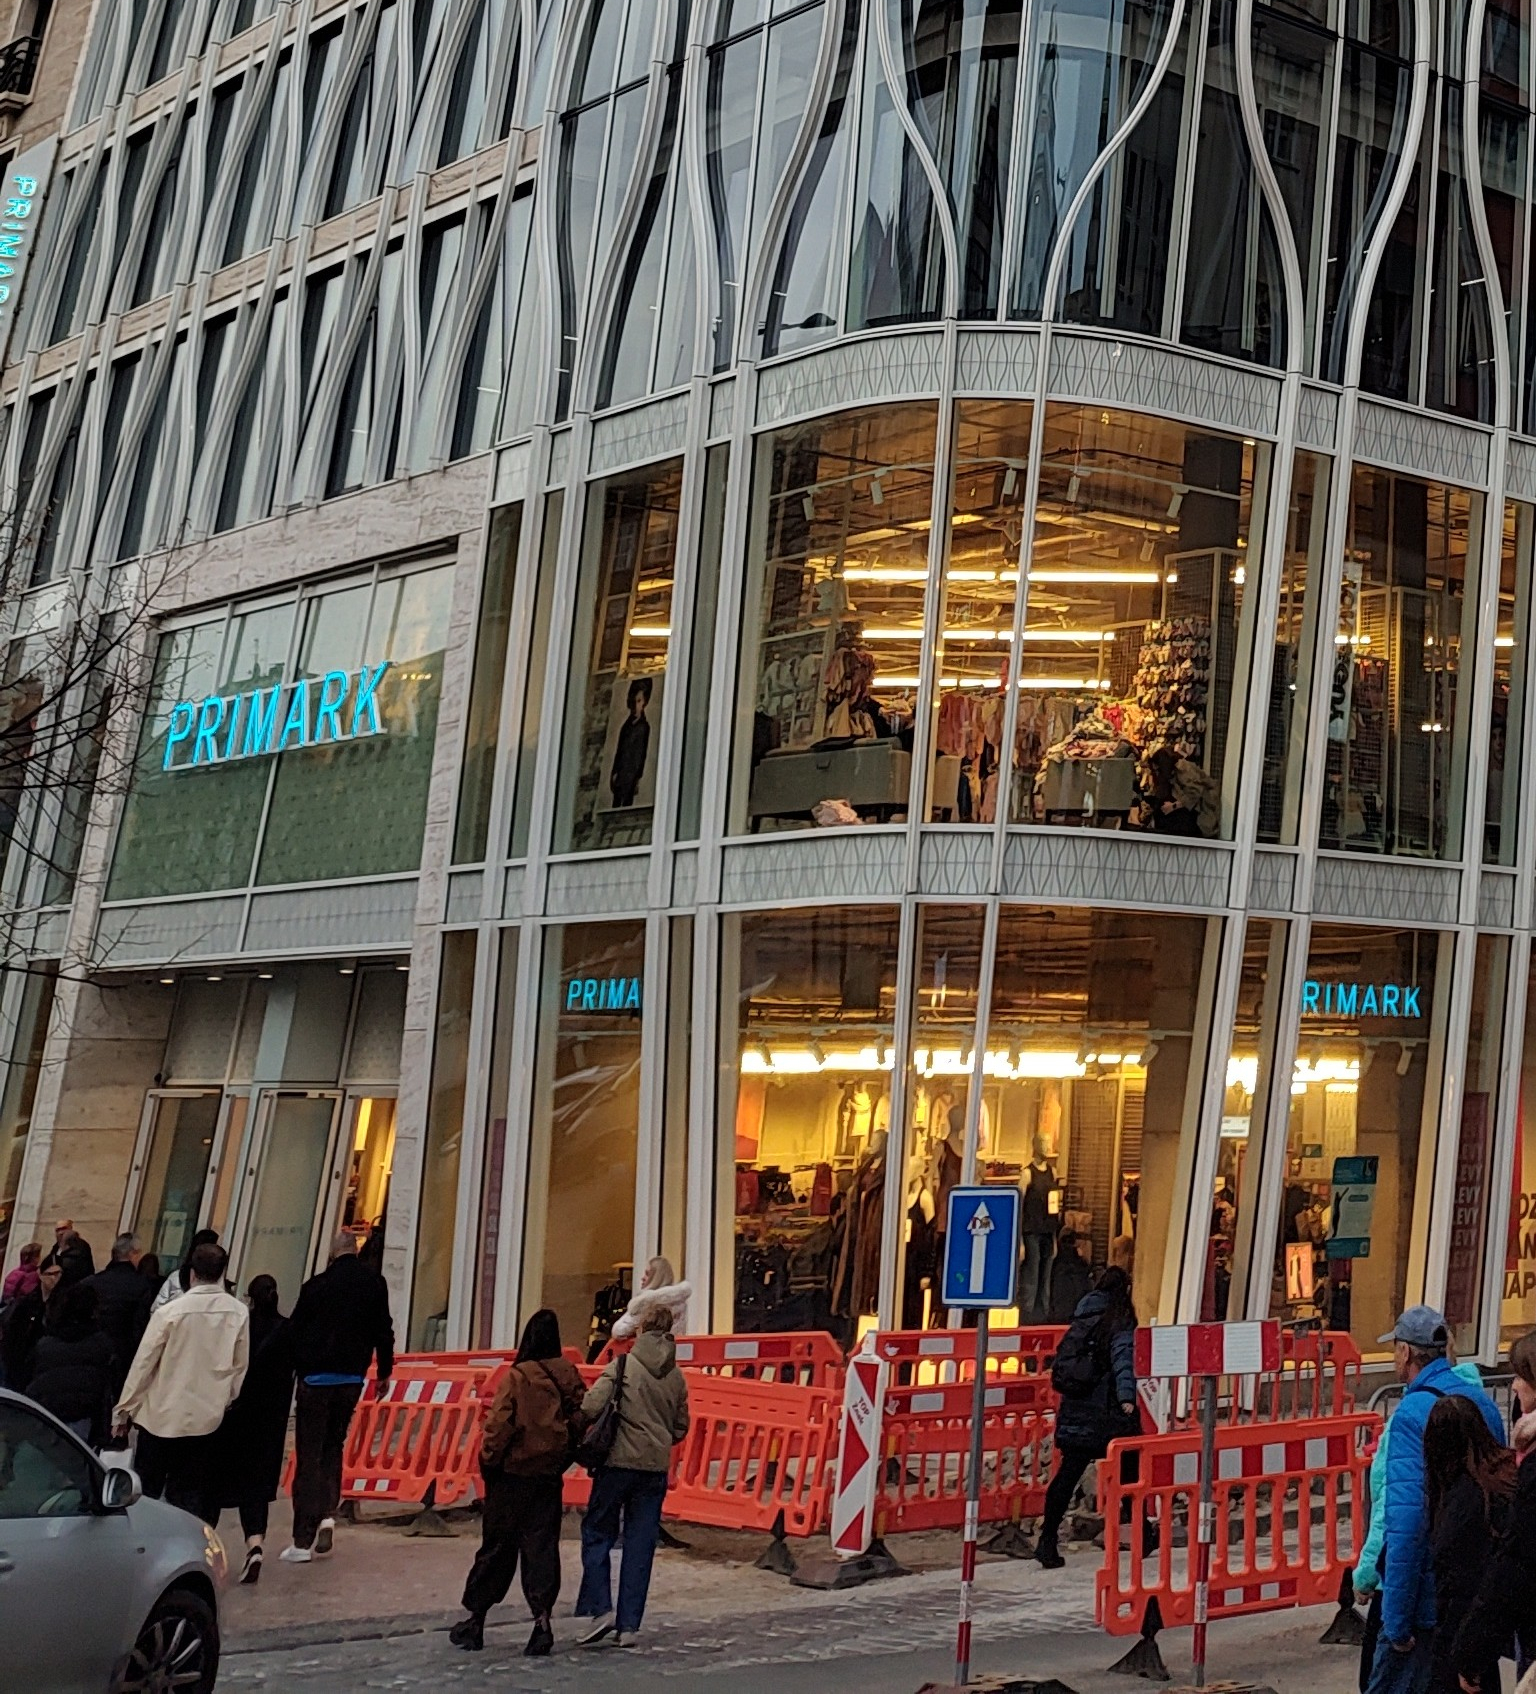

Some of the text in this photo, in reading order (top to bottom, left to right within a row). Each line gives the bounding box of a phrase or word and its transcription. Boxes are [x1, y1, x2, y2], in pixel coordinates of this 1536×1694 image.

[163, 660, 389, 772] PRIMARK
[566, 977, 640, 1011] PRIMA
[1302, 979, 1421, 1018] RIMARK
